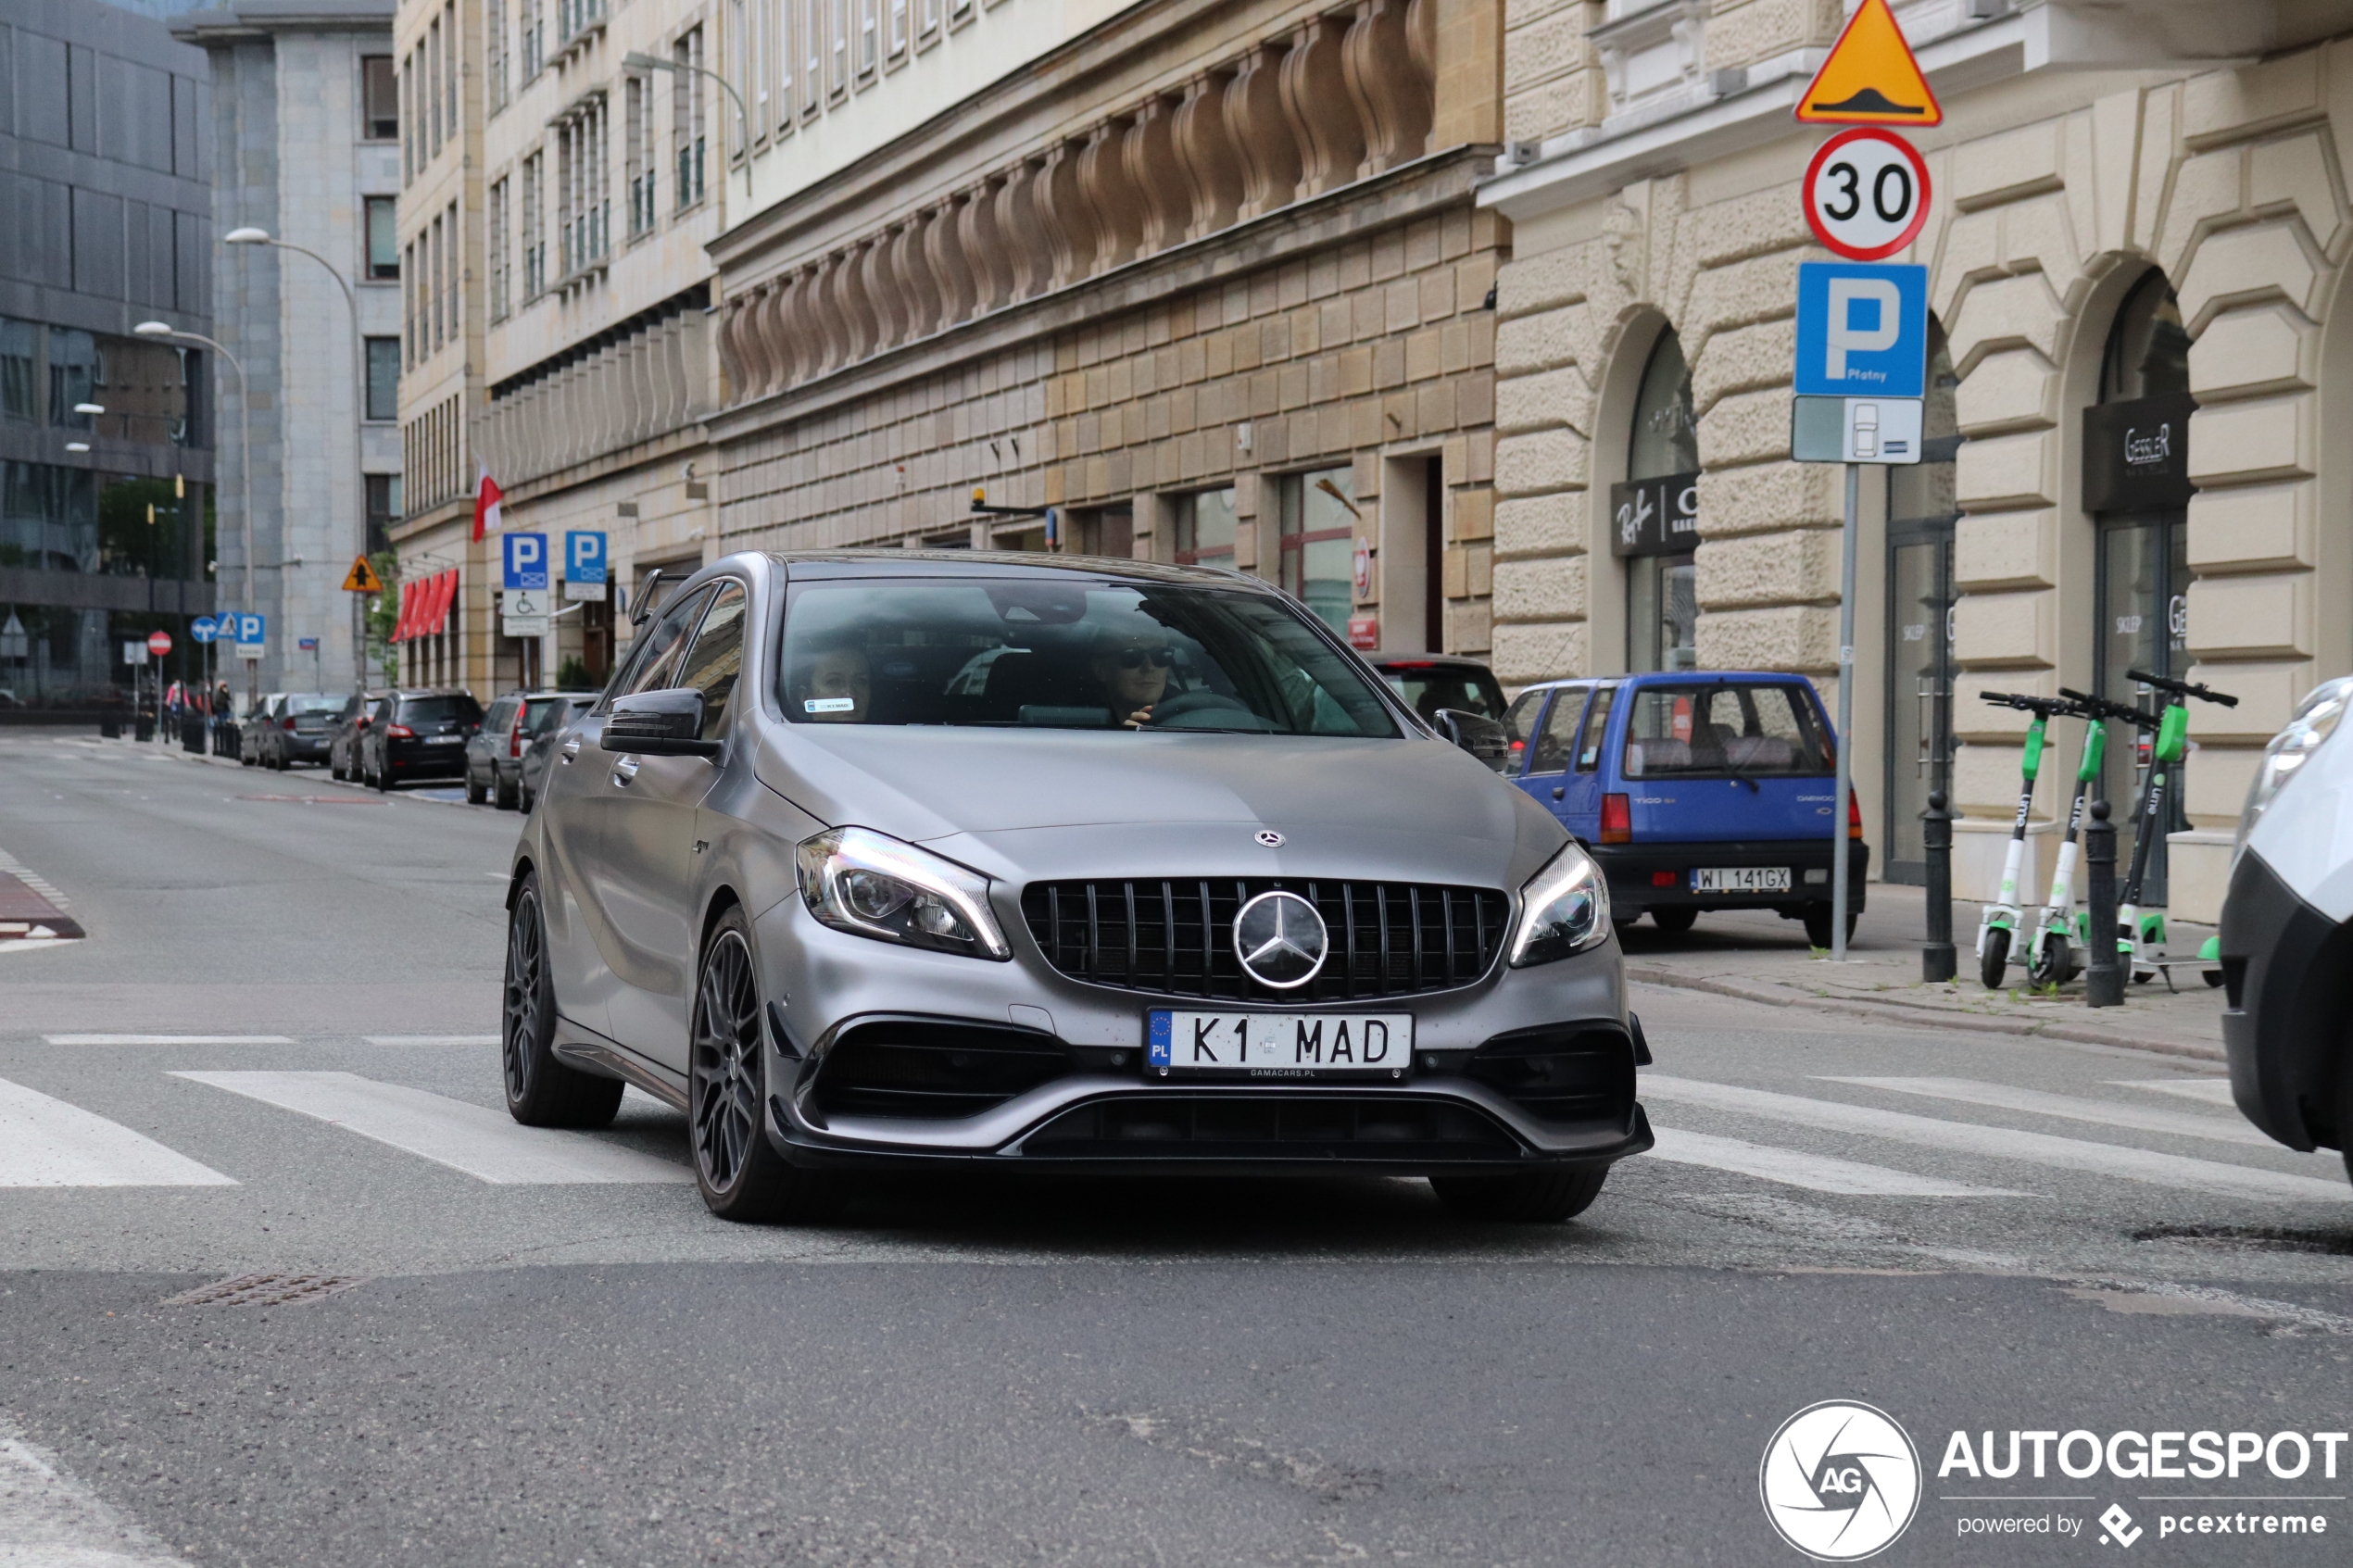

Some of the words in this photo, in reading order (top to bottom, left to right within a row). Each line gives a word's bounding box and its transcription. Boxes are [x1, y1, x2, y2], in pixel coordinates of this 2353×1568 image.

[1824, 161, 1911, 223] 30
[1825, 278, 1901, 380] P
[1847, 368, 1887, 383] Płatny
[512, 536, 540, 573] P
[574, 534, 599, 568] P
[241, 617, 259, 641] P
[1701, 870, 1722, 888] WI
[1735, 870, 1788, 887] 141GX
[1152, 1045, 1168, 1058] PL
[1194, 1017, 1248, 1062] K1
[1296, 1019, 1389, 1063] MAD
[1251, 1069, 1315, 1077] GAMACARS.PL
